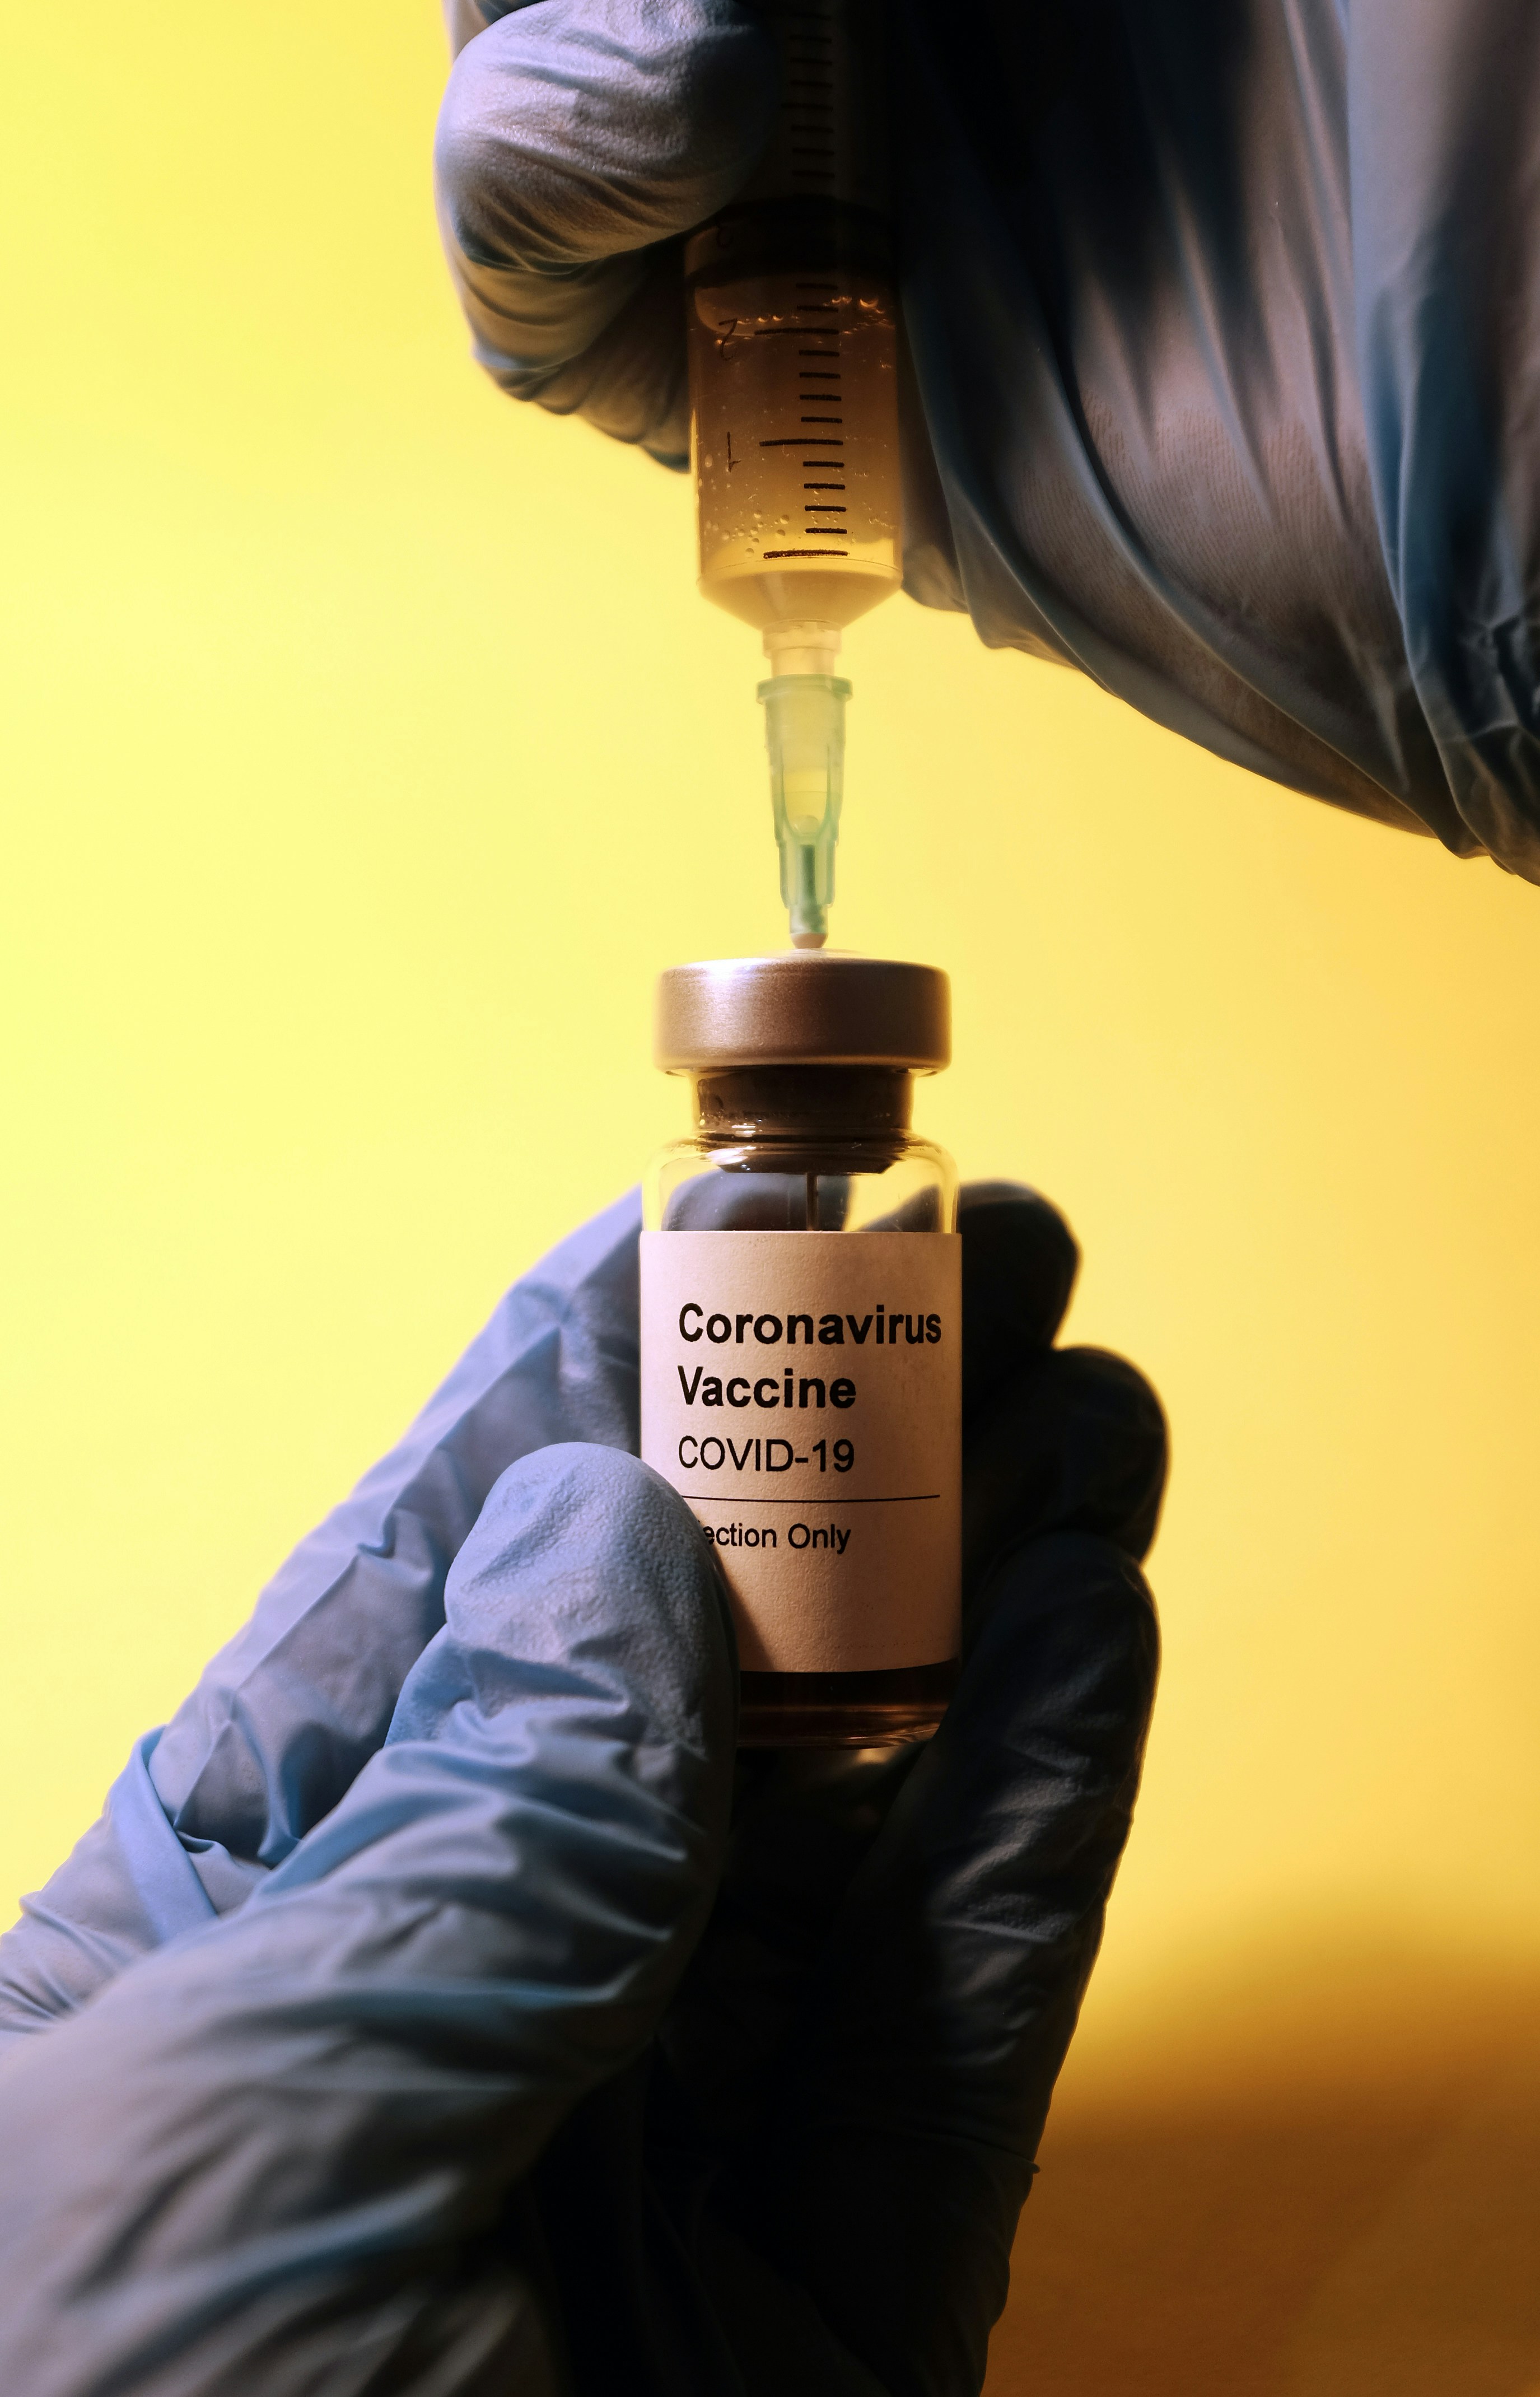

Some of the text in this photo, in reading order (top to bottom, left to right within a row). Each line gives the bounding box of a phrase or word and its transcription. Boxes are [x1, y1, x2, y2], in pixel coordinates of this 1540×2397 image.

[727, 431, 741, 472] 1
[679, 1302, 941, 1345] Coronavirus
[677, 1365, 856, 1409] Vaccine
[678, 1435, 855, 1472] COVID-19
[698, 1520, 852, 1555] ection Only
